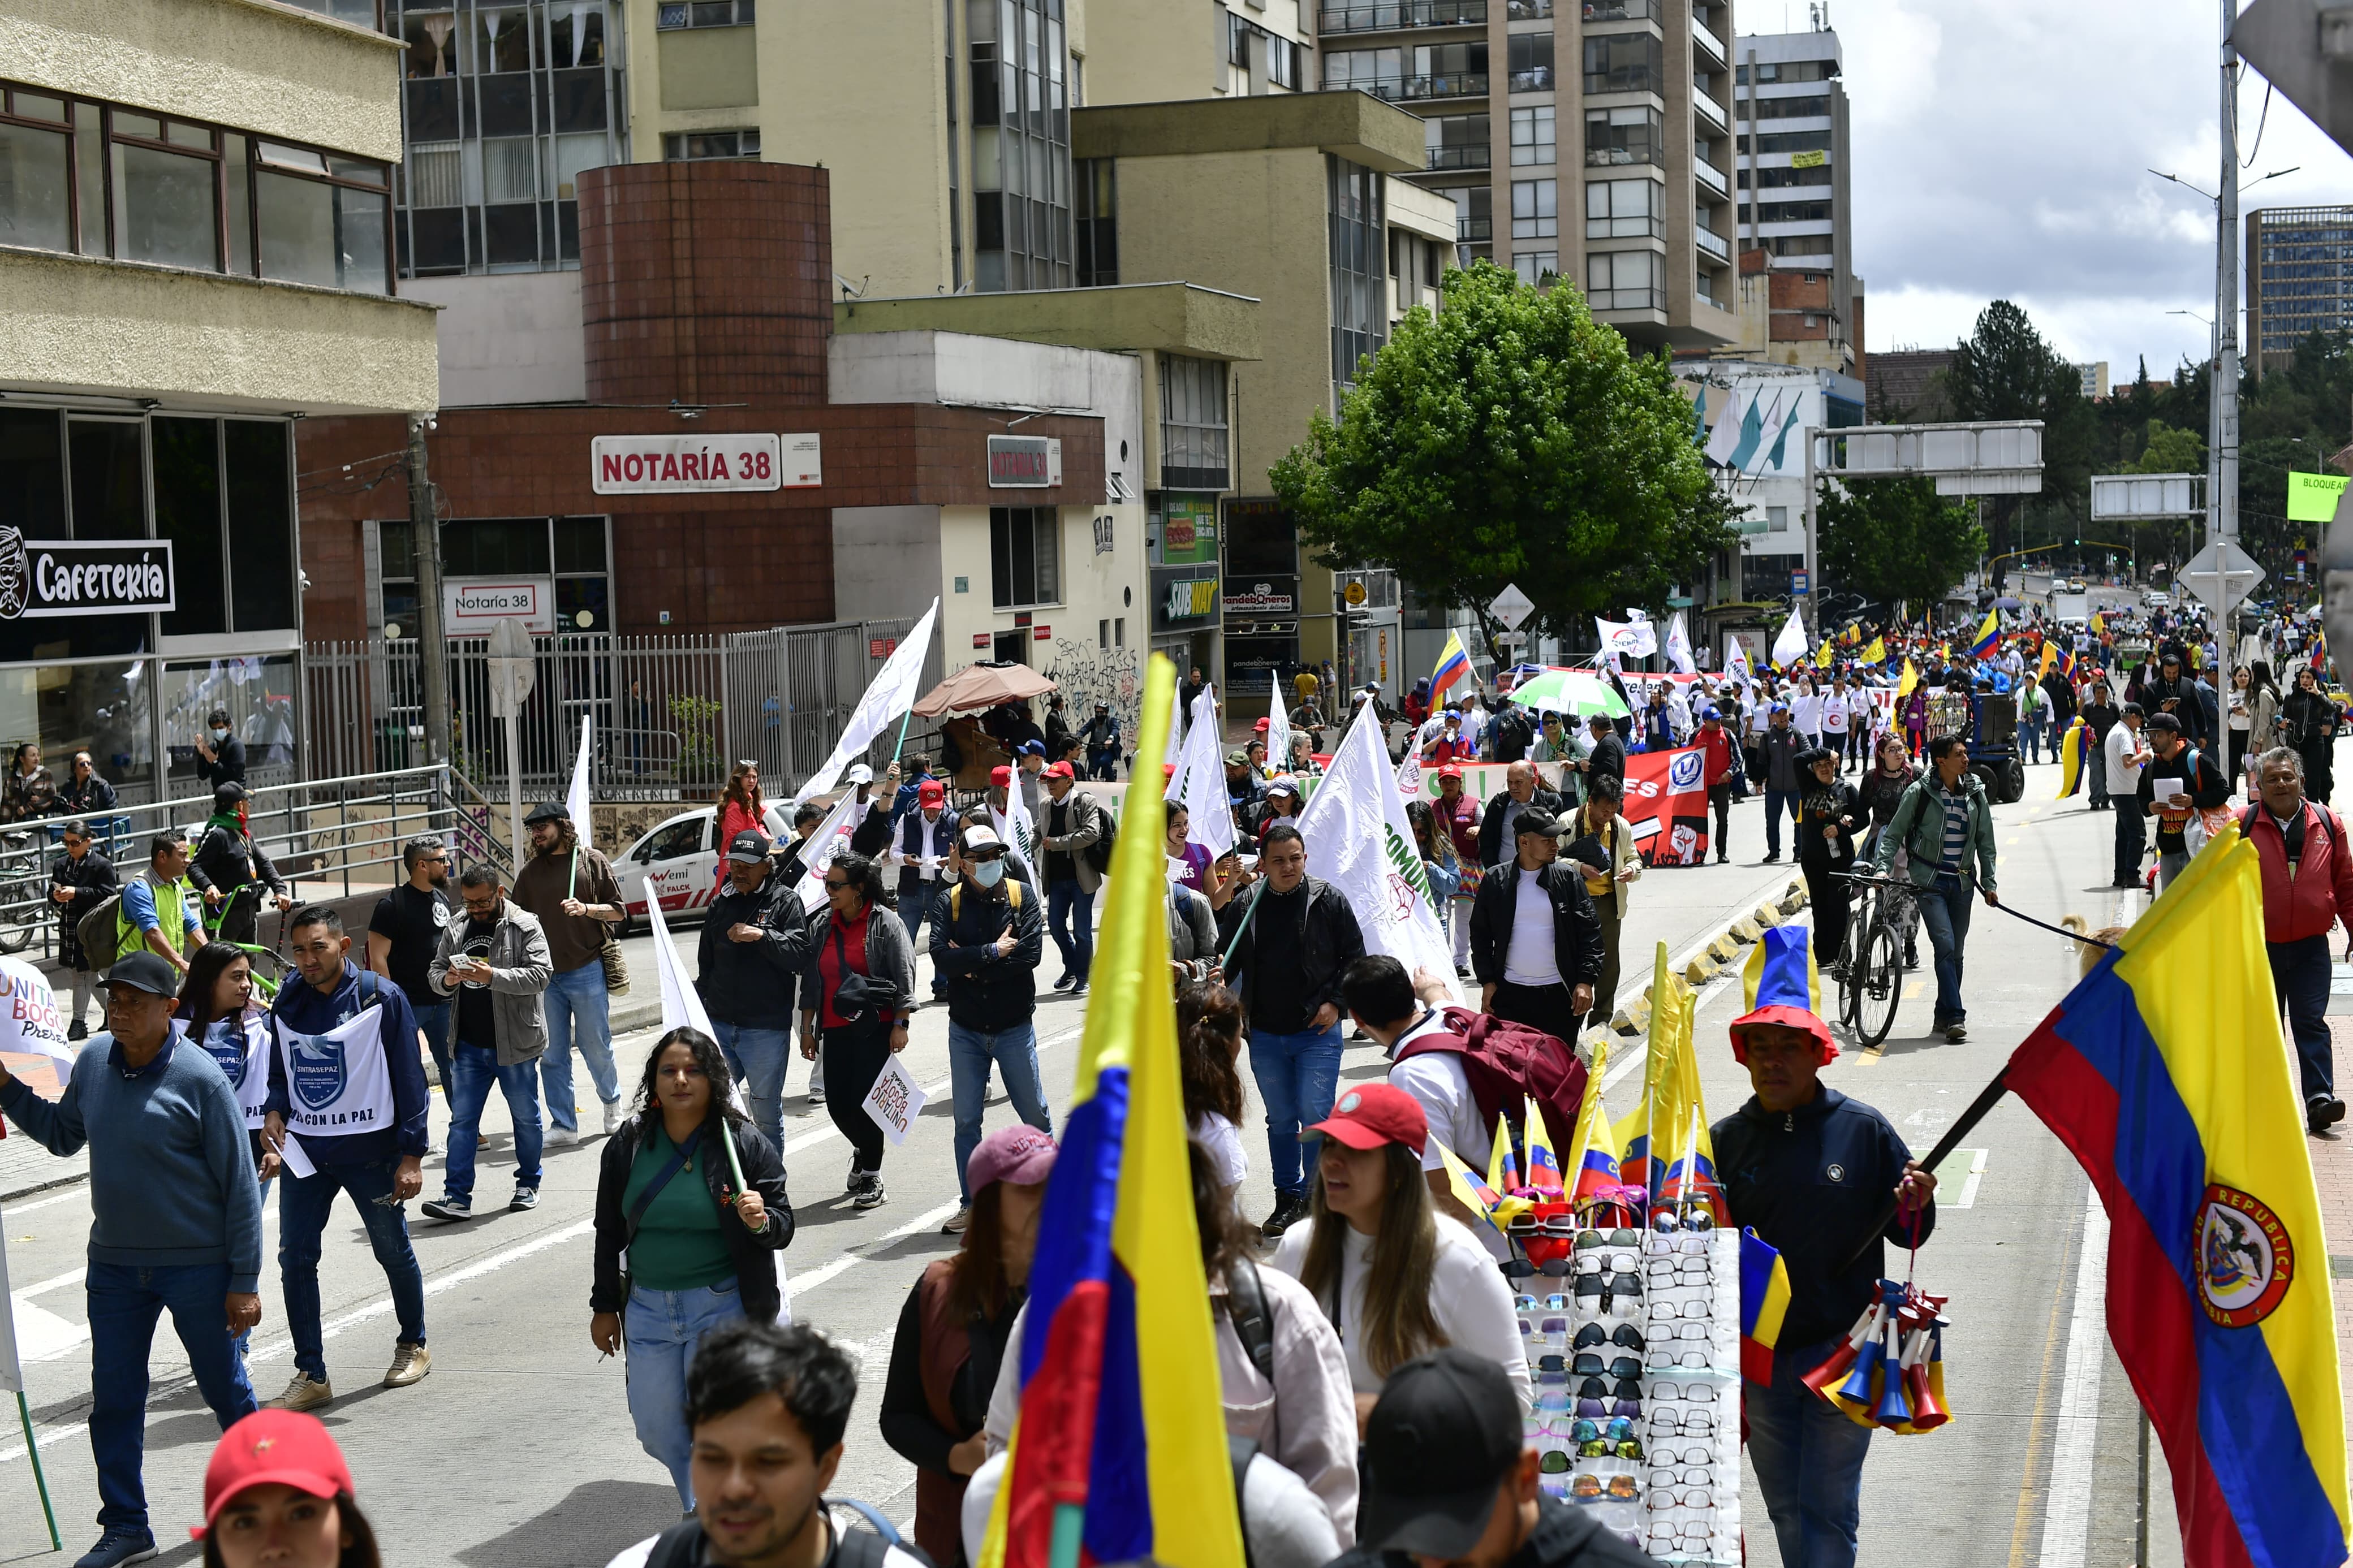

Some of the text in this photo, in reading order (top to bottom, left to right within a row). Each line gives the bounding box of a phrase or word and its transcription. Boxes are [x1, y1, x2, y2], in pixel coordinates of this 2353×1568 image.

[602, 446, 770, 482] NOTARÍA 38
[456, 595, 528, 609] Notaría 38
[1167, 577, 1218, 618] SUBWAY
[1729, 660, 1751, 689] ANEBRE
[667, 884, 691, 892] FALCK
[305, 1114, 326, 1125] CON
[331, 1113, 347, 1125] LA
[351, 1108, 374, 1122] PAZ
[871, 1087, 908, 1133] UNITARIO
[2218, 1189, 2290, 1281] REPUBLICA
